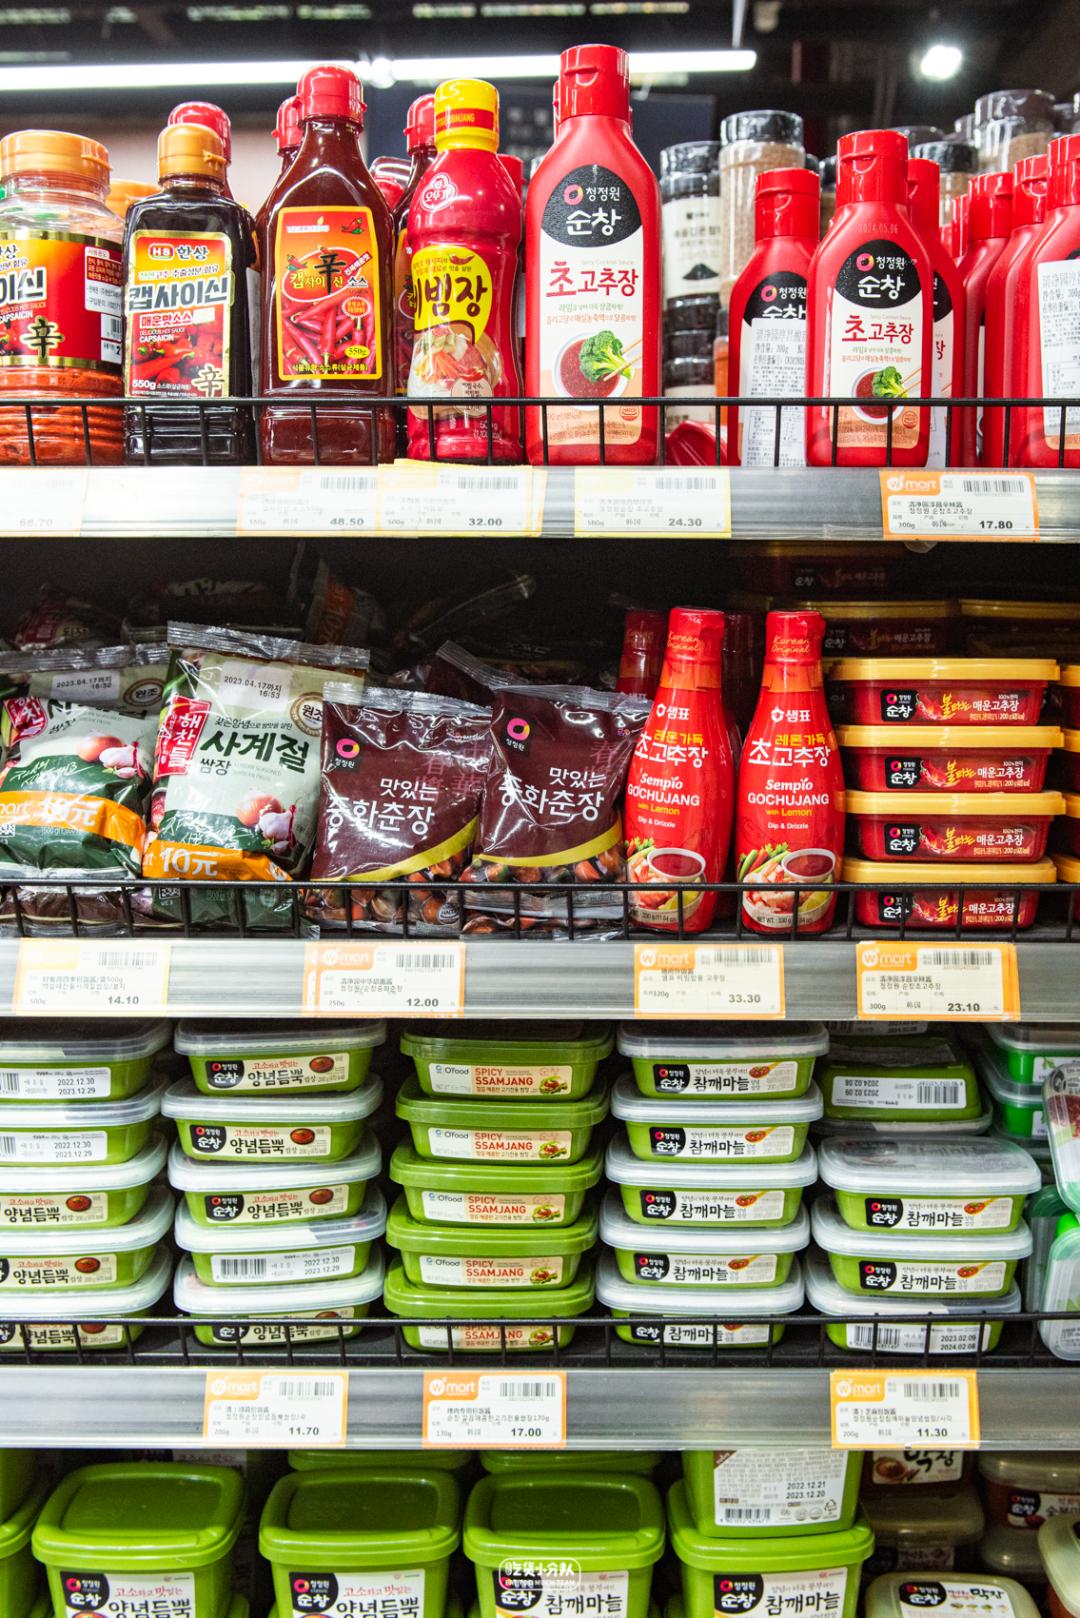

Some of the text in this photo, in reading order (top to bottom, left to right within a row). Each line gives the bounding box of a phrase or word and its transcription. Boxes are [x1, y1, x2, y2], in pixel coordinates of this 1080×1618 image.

[586, 186, 620, 201] 청정원
[566, 207, 622, 236] 순창
[151, 248, 172, 257] HS
[177, 245, 208, 260] 한상
[876, 256, 905, 270] 청정원
[290, 272, 344, 289] 캡사이신
[314, 253, 346, 295] 辛
[546, 261, 639, 297] 초고추장
[348, 277, 368, 287] 소스
[858, 274, 905, 299] 순창
[129, 277, 229, 311] 캡사이신
[141, 315, 192, 327] 매운맛소스
[842, 315, 915, 344] 초고추장
[23, 318, 64, 358] 辛
[132, 379, 156, 390] 550g
[193, 366, 225, 397] 辛
[330, 518, 364, 526] 48.50
[468, 518, 503, 527] 32.00
[668, 517, 702, 527] 24.30
[979, 520, 1013, 529] 17.80
[773, 635, 810, 646] Korean
[771, 645, 810, 657] Original
[224, 675, 282, 692] 2023.04.17까지
[259, 690, 281, 699] 16:53
[886, 705, 913, 718] 순창
[972, 700, 1019, 712] 매운고추장
[666, 707, 690, 720] 샘표
[785, 709, 811, 722] 샘표
[167, 713, 203, 768] 해찬들
[506, 738, 525, 751] 청정원
[775, 734, 826, 746] 레몬 가득
[200, 730, 310, 774] 사계절
[634, 731, 709, 768] 초고추장
[748, 738, 831, 769] 초고추장
[200, 757, 232, 776] 쌈장
[334, 757, 355, 769] 청정원
[549, 767, 607, 788] 맛있는
[891, 772, 917, 785] 순창
[977, 767, 1024, 779] 매운고추장
[640, 773, 684, 790] Sempio
[765, 777, 813, 794] Sempio
[380, 778, 440, 801] 맛있는
[628, 783, 700, 806] GOCHUJANG
[499, 773, 604, 821] 중화춘장
[747, 793, 829, 806] GOCHUJANG
[650, 804, 680, 815] Lemon
[781, 807, 812, 817] Lemon
[326, 796, 436, 837] 중화춘장
[767, 822, 778, 831] Dip
[787, 822, 809, 830] Drizzle
[890, 838, 916, 852] 순창
[976, 834, 1024, 846] 매운고추장
[162, 846, 218, 877] 10元
[968, 902, 1015, 915] 매운고추장
[108, 995, 139, 1005] 14.10
[407, 998, 439, 1007] 12.00
[728, 993, 761, 1003] 33.30
[869, 1002, 886, 1011] 300g
[947, 1003, 980, 1012] 23.10
[214, 1072, 238, 1084] 순창
[248, 1069, 303, 1086] 양념듬뿍
[475, 1068, 503, 1077] SPICY
[475, 1077, 533, 1086] SSAMJANG
[660, 1079, 685, 1090] 순창
[693, 1076, 749, 1092] 참깨마늘
[197, 1136, 222, 1149] 순창
[475, 1132, 503, 1141] SPICY
[230, 1138, 285, 1154] 양념듬뿍
[475, 1142, 533, 1151] SSAMJANG
[656, 1141, 681, 1153] 순창
[689, 1139, 745, 1156] 참깨마늘
[468, 1196, 496, 1204] SPICY
[4, 1206, 60, 1223] 양념듬뿍
[213, 1205, 238, 1217] 순창
[248, 1201, 303, 1219] 양념듬뿍
[468, 1205, 526, 1214] SSAMJANG
[647, 1205, 671, 1216] 순창
[680, 1203, 736, 1219] 참깨마늘
[872, 1213, 898, 1224] 순창
[907, 1211, 963, 1227] 참깨마늘
[466, 1260, 494, 1268] SPICY
[13, 1269, 69, 1285] 양념듬뿍
[466, 1269, 524, 1277] SSAMJANG
[640, 1268, 665, 1279] 순창
[673, 1267, 729, 1282] 참깨마늘
[866, 1276, 891, 1288] 순창
[900, 1275, 957, 1291] 참깨마늘
[636, 1326, 660, 1339] 순창
[289, 1426, 319, 1435] 11.70
[511, 1427, 542, 1437] 17.00
[843, 1430, 859, 1438] 200g
[917, 1427, 948, 1437] 11.30
[70, 1592, 102, 1608] 순창
[297, 1593, 330, 1608] 순창
[500, 1589, 536, 1607] 순창
[544, 1593, 623, 1616] 참깨마늘
[721, 1592, 756, 1608] 순창
[765, 1591, 840, 1616] 참깨마늘
